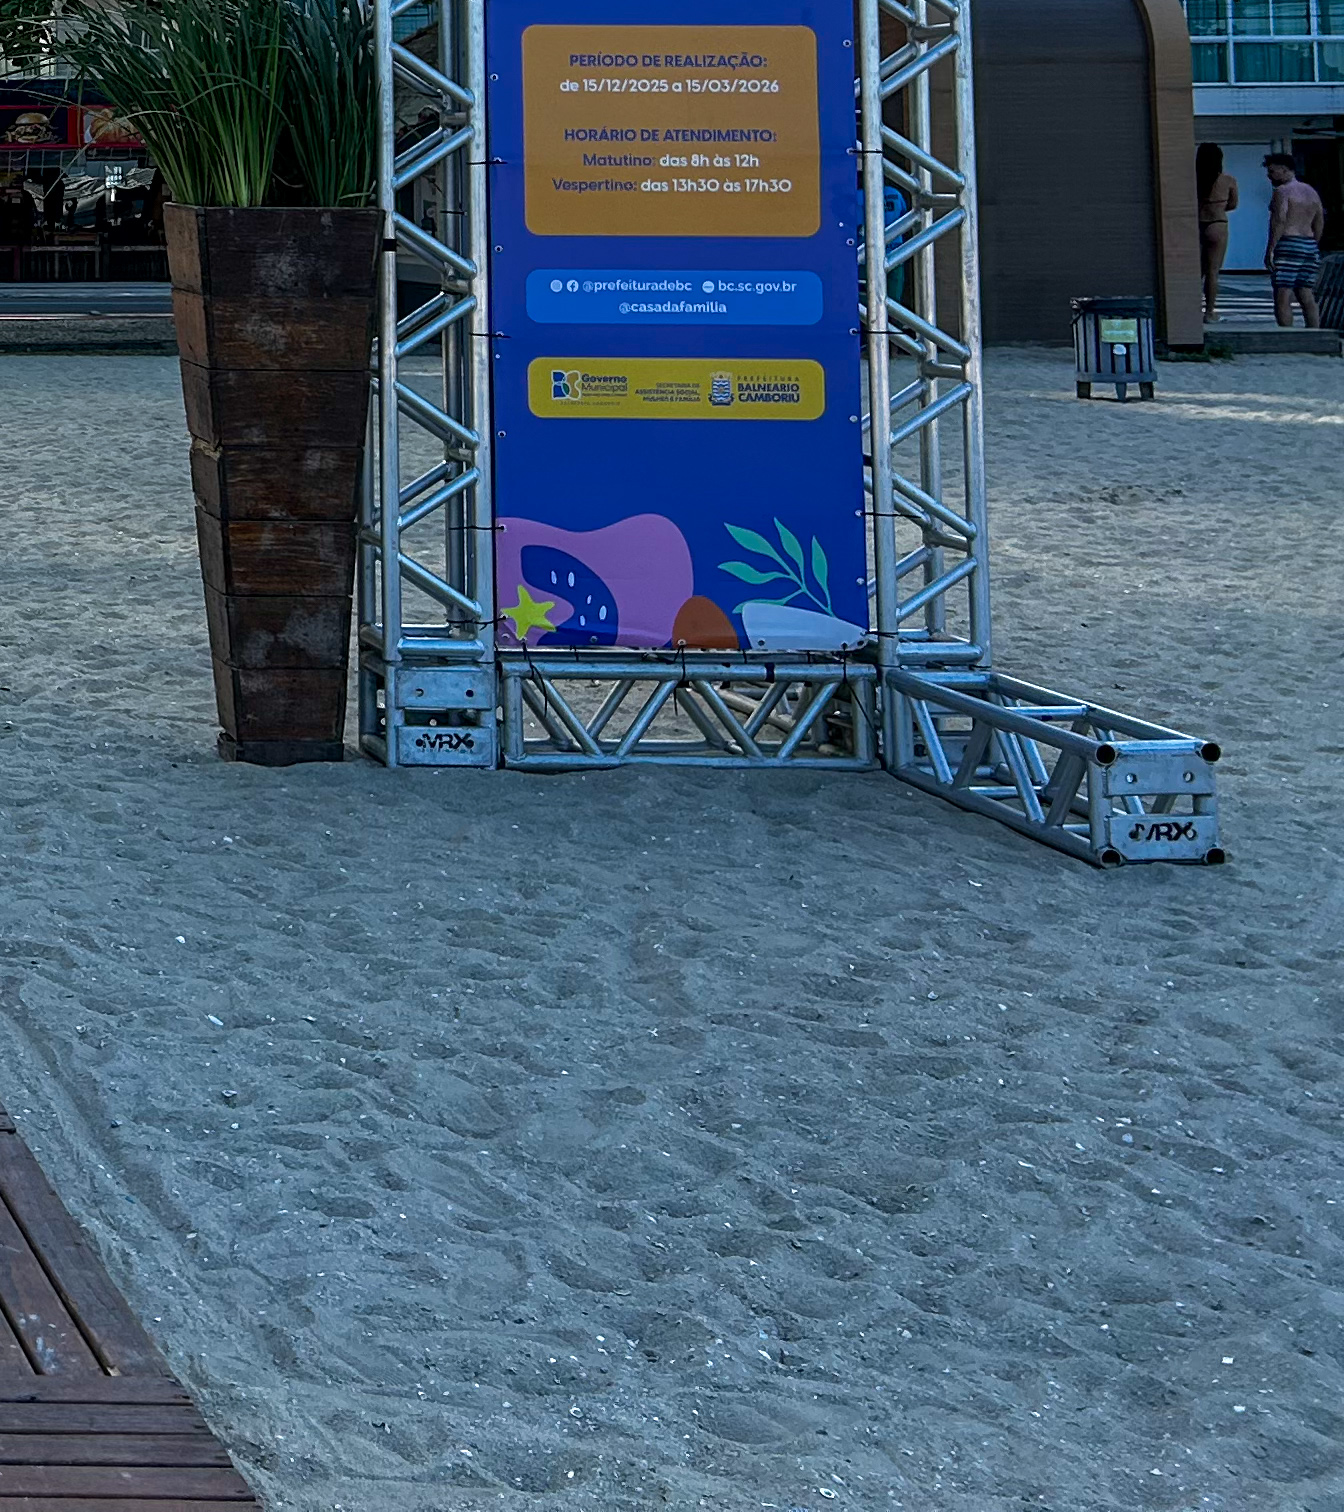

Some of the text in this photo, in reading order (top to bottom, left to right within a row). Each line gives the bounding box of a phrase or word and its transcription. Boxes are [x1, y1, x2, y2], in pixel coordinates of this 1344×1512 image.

[569, 51, 768, 71] PERÍODO DE REALIZAÇÃO:
[559, 78, 780, 94] de 15/12/2025 a 15/03/2026
[564, 126, 777, 142] HORÁRIO DE ATENDIMENTO:
[582, 153, 760, 167] Matutino: das 8h às 12h
[551, 178, 792, 194] Vespertino: das 13h30 às 17h30
[582, 279, 798, 294] @prefeituradebc bc.sc.gov.br
[581, 373, 628, 383] Governo
